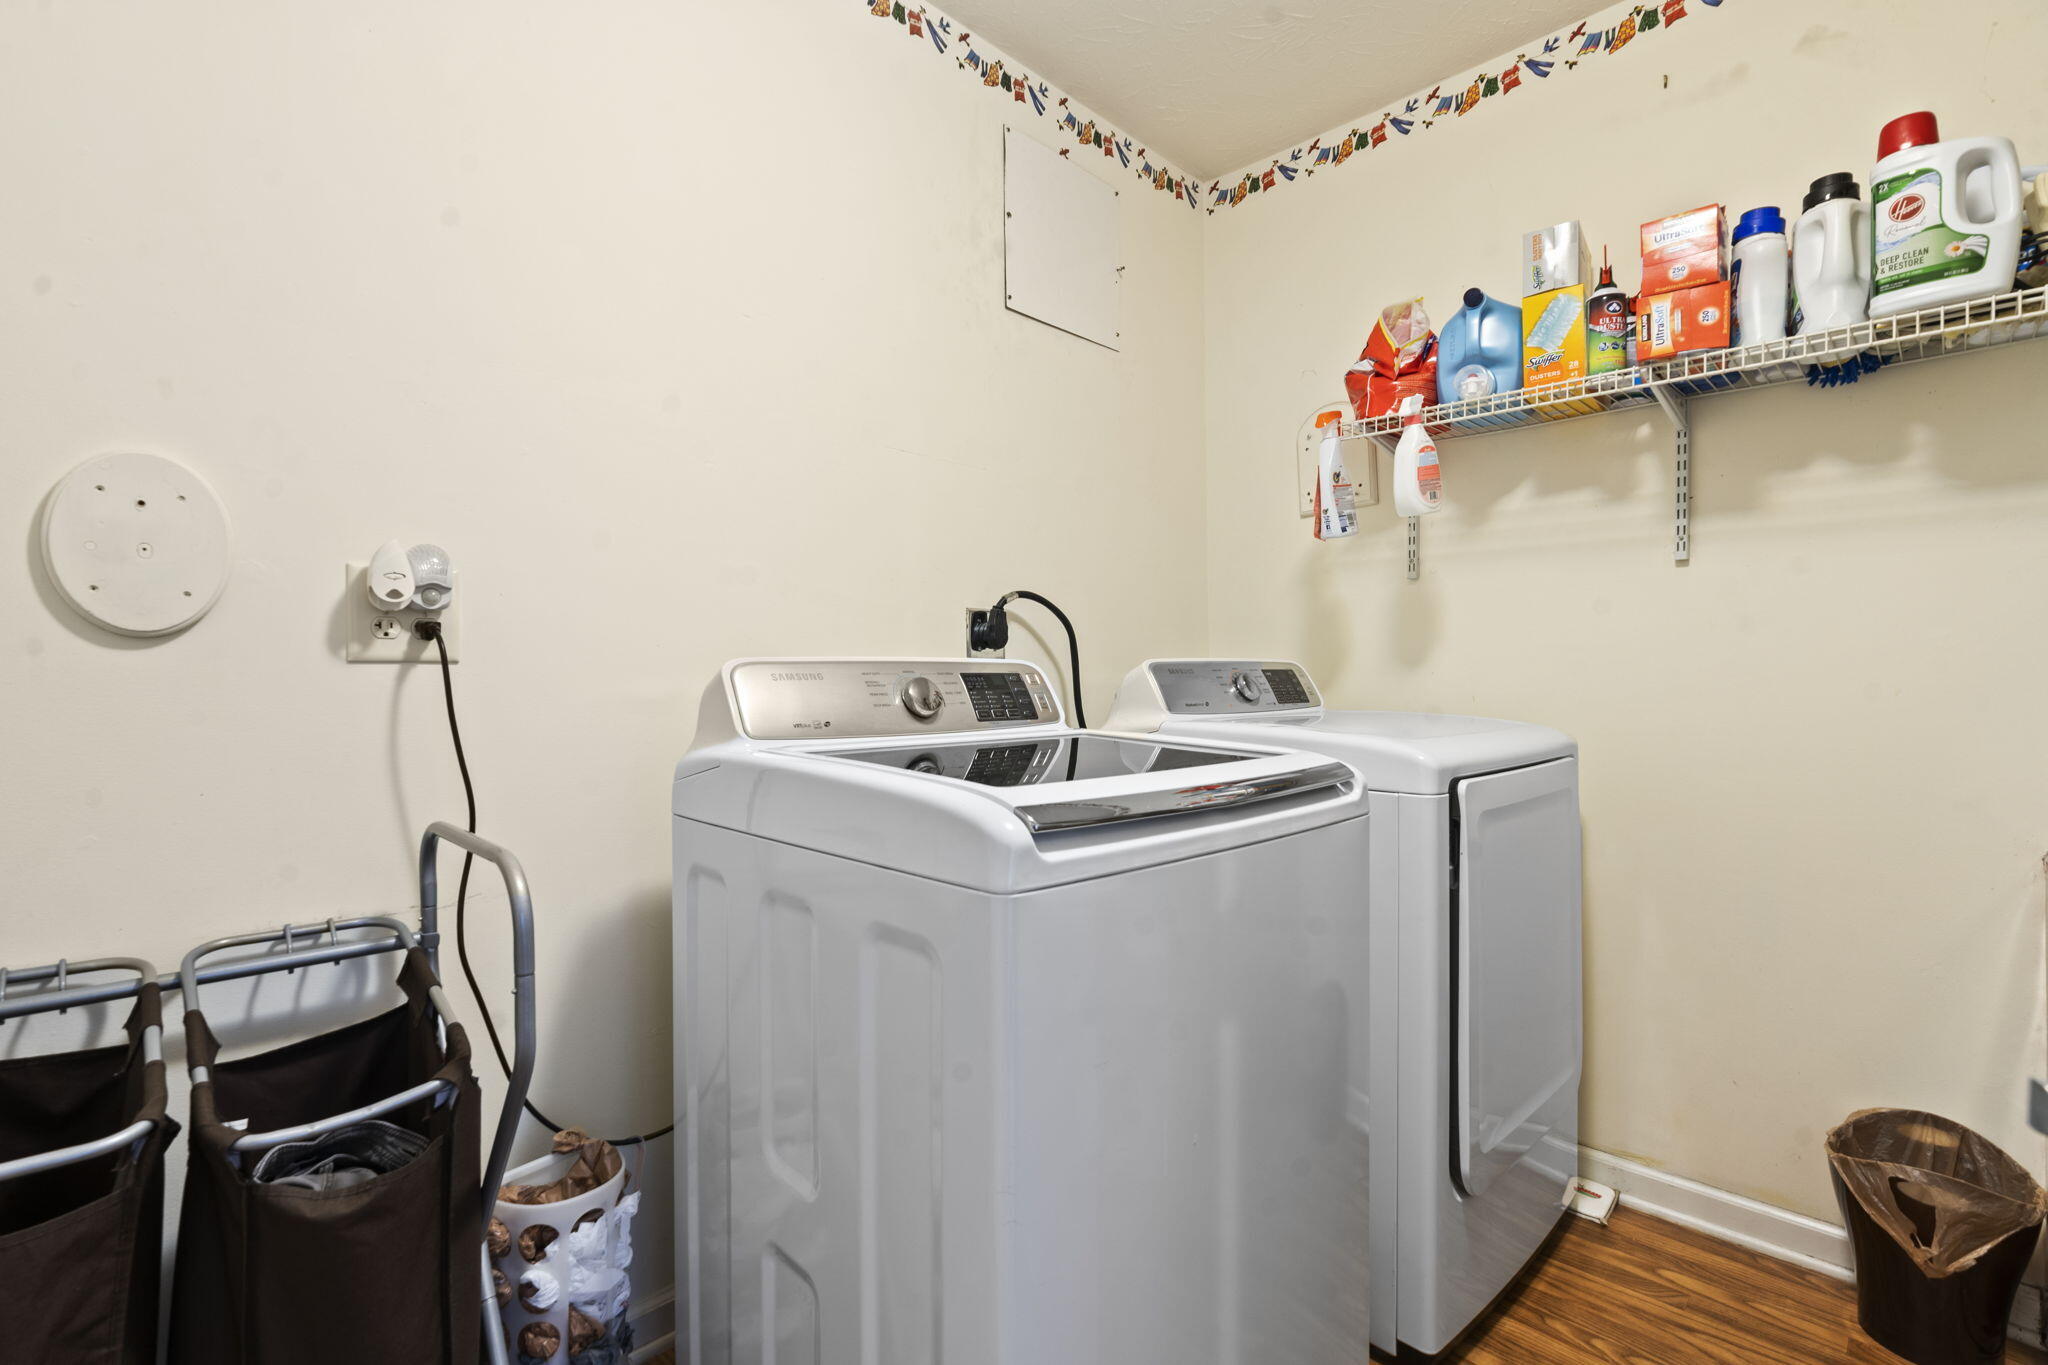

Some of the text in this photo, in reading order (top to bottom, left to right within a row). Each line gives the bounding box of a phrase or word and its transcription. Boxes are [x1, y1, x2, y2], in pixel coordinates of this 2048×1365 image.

[1879, 183, 1889, 193] 2X
[1880, 247, 1929, 267] DEEP CLEAN
[1671, 265, 1686, 274] 250
[1888, 257, 1925, 272] RESTORE
[1599, 316, 1626, 325] ULTRA
[1702, 310, 1710, 323] 250
[1655, 305, 1666, 346] UltraSoft
[1525, 352, 1564, 368] Swiffer
[1529, 370, 1561, 381] DUSTERS
[770, 671, 824, 682] SAMSUNG
